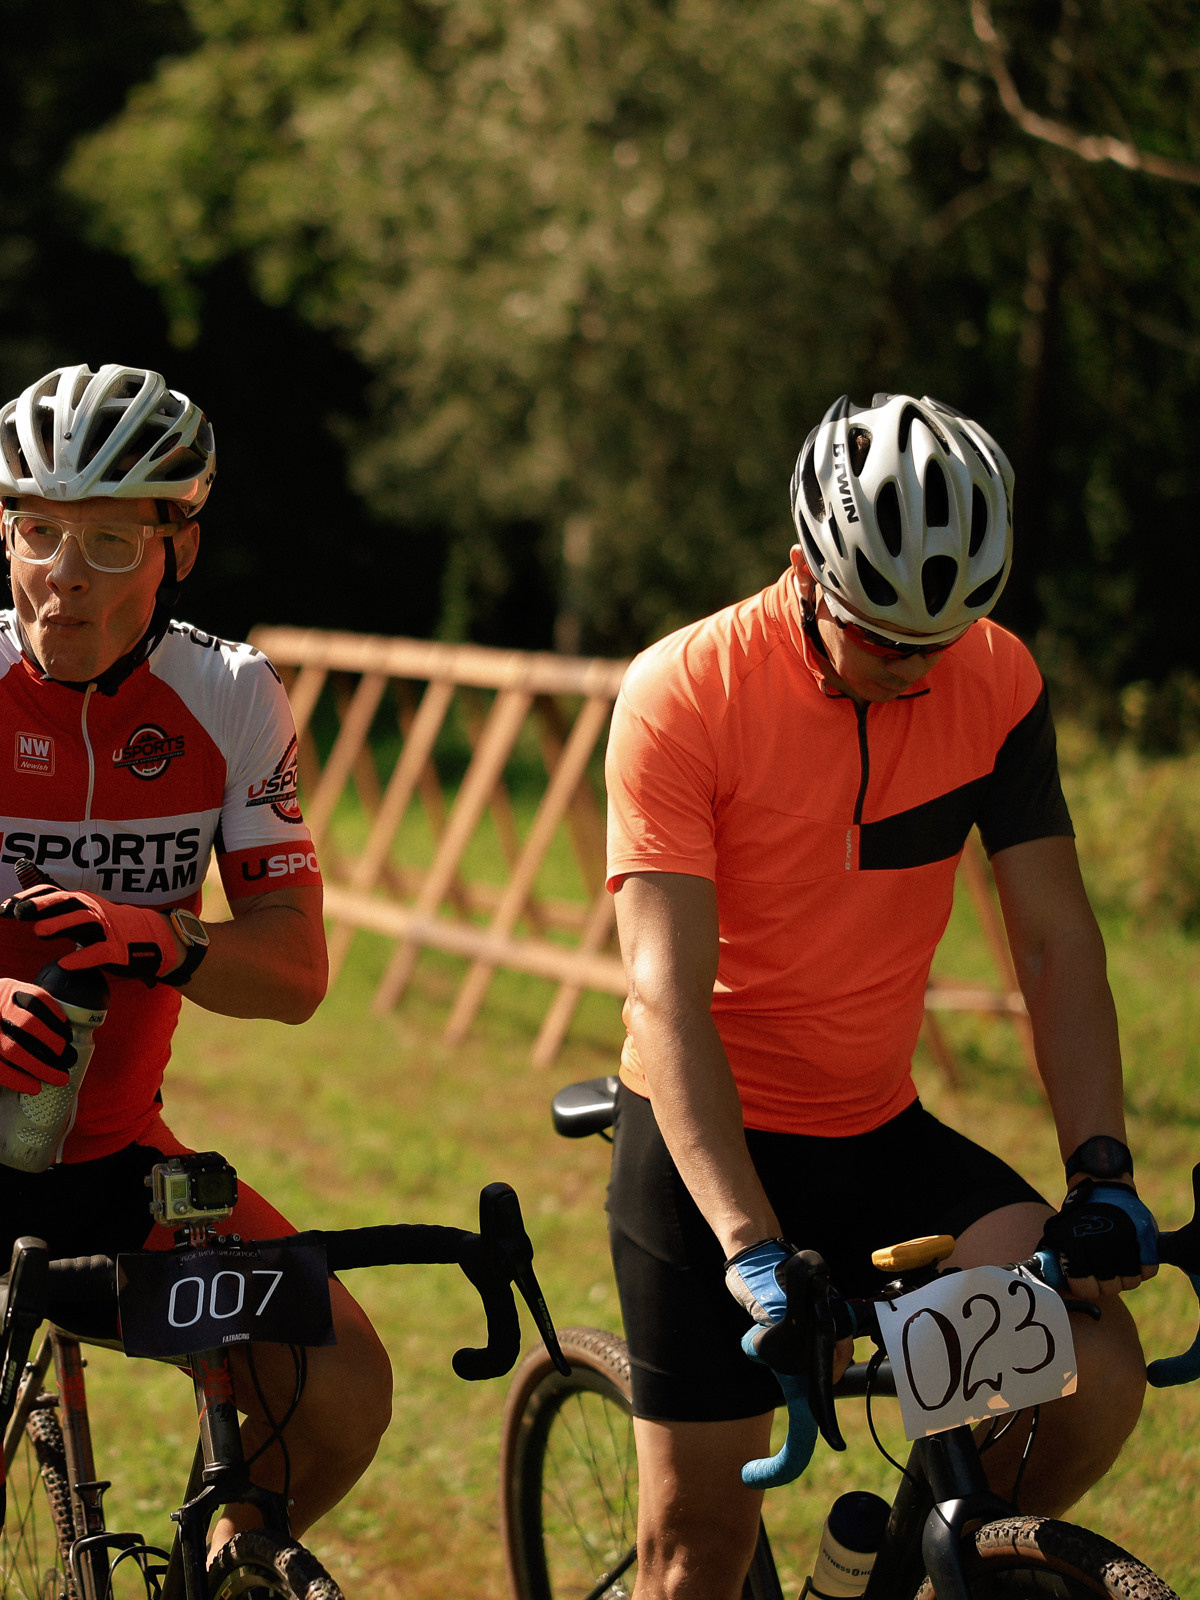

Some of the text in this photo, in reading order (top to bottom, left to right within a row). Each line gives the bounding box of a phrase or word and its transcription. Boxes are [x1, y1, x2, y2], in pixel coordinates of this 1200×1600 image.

[20, 736, 50, 757] NW
[112, 735, 186, 762] USPORTS
[21, 761, 49, 771] Newish
[96, 860, 198, 893] TEAM
[168, 1270, 283, 1327] 007
[222, 1333, 250, 1344] FATRACING
[902, 1280, 1055, 1411] 023
